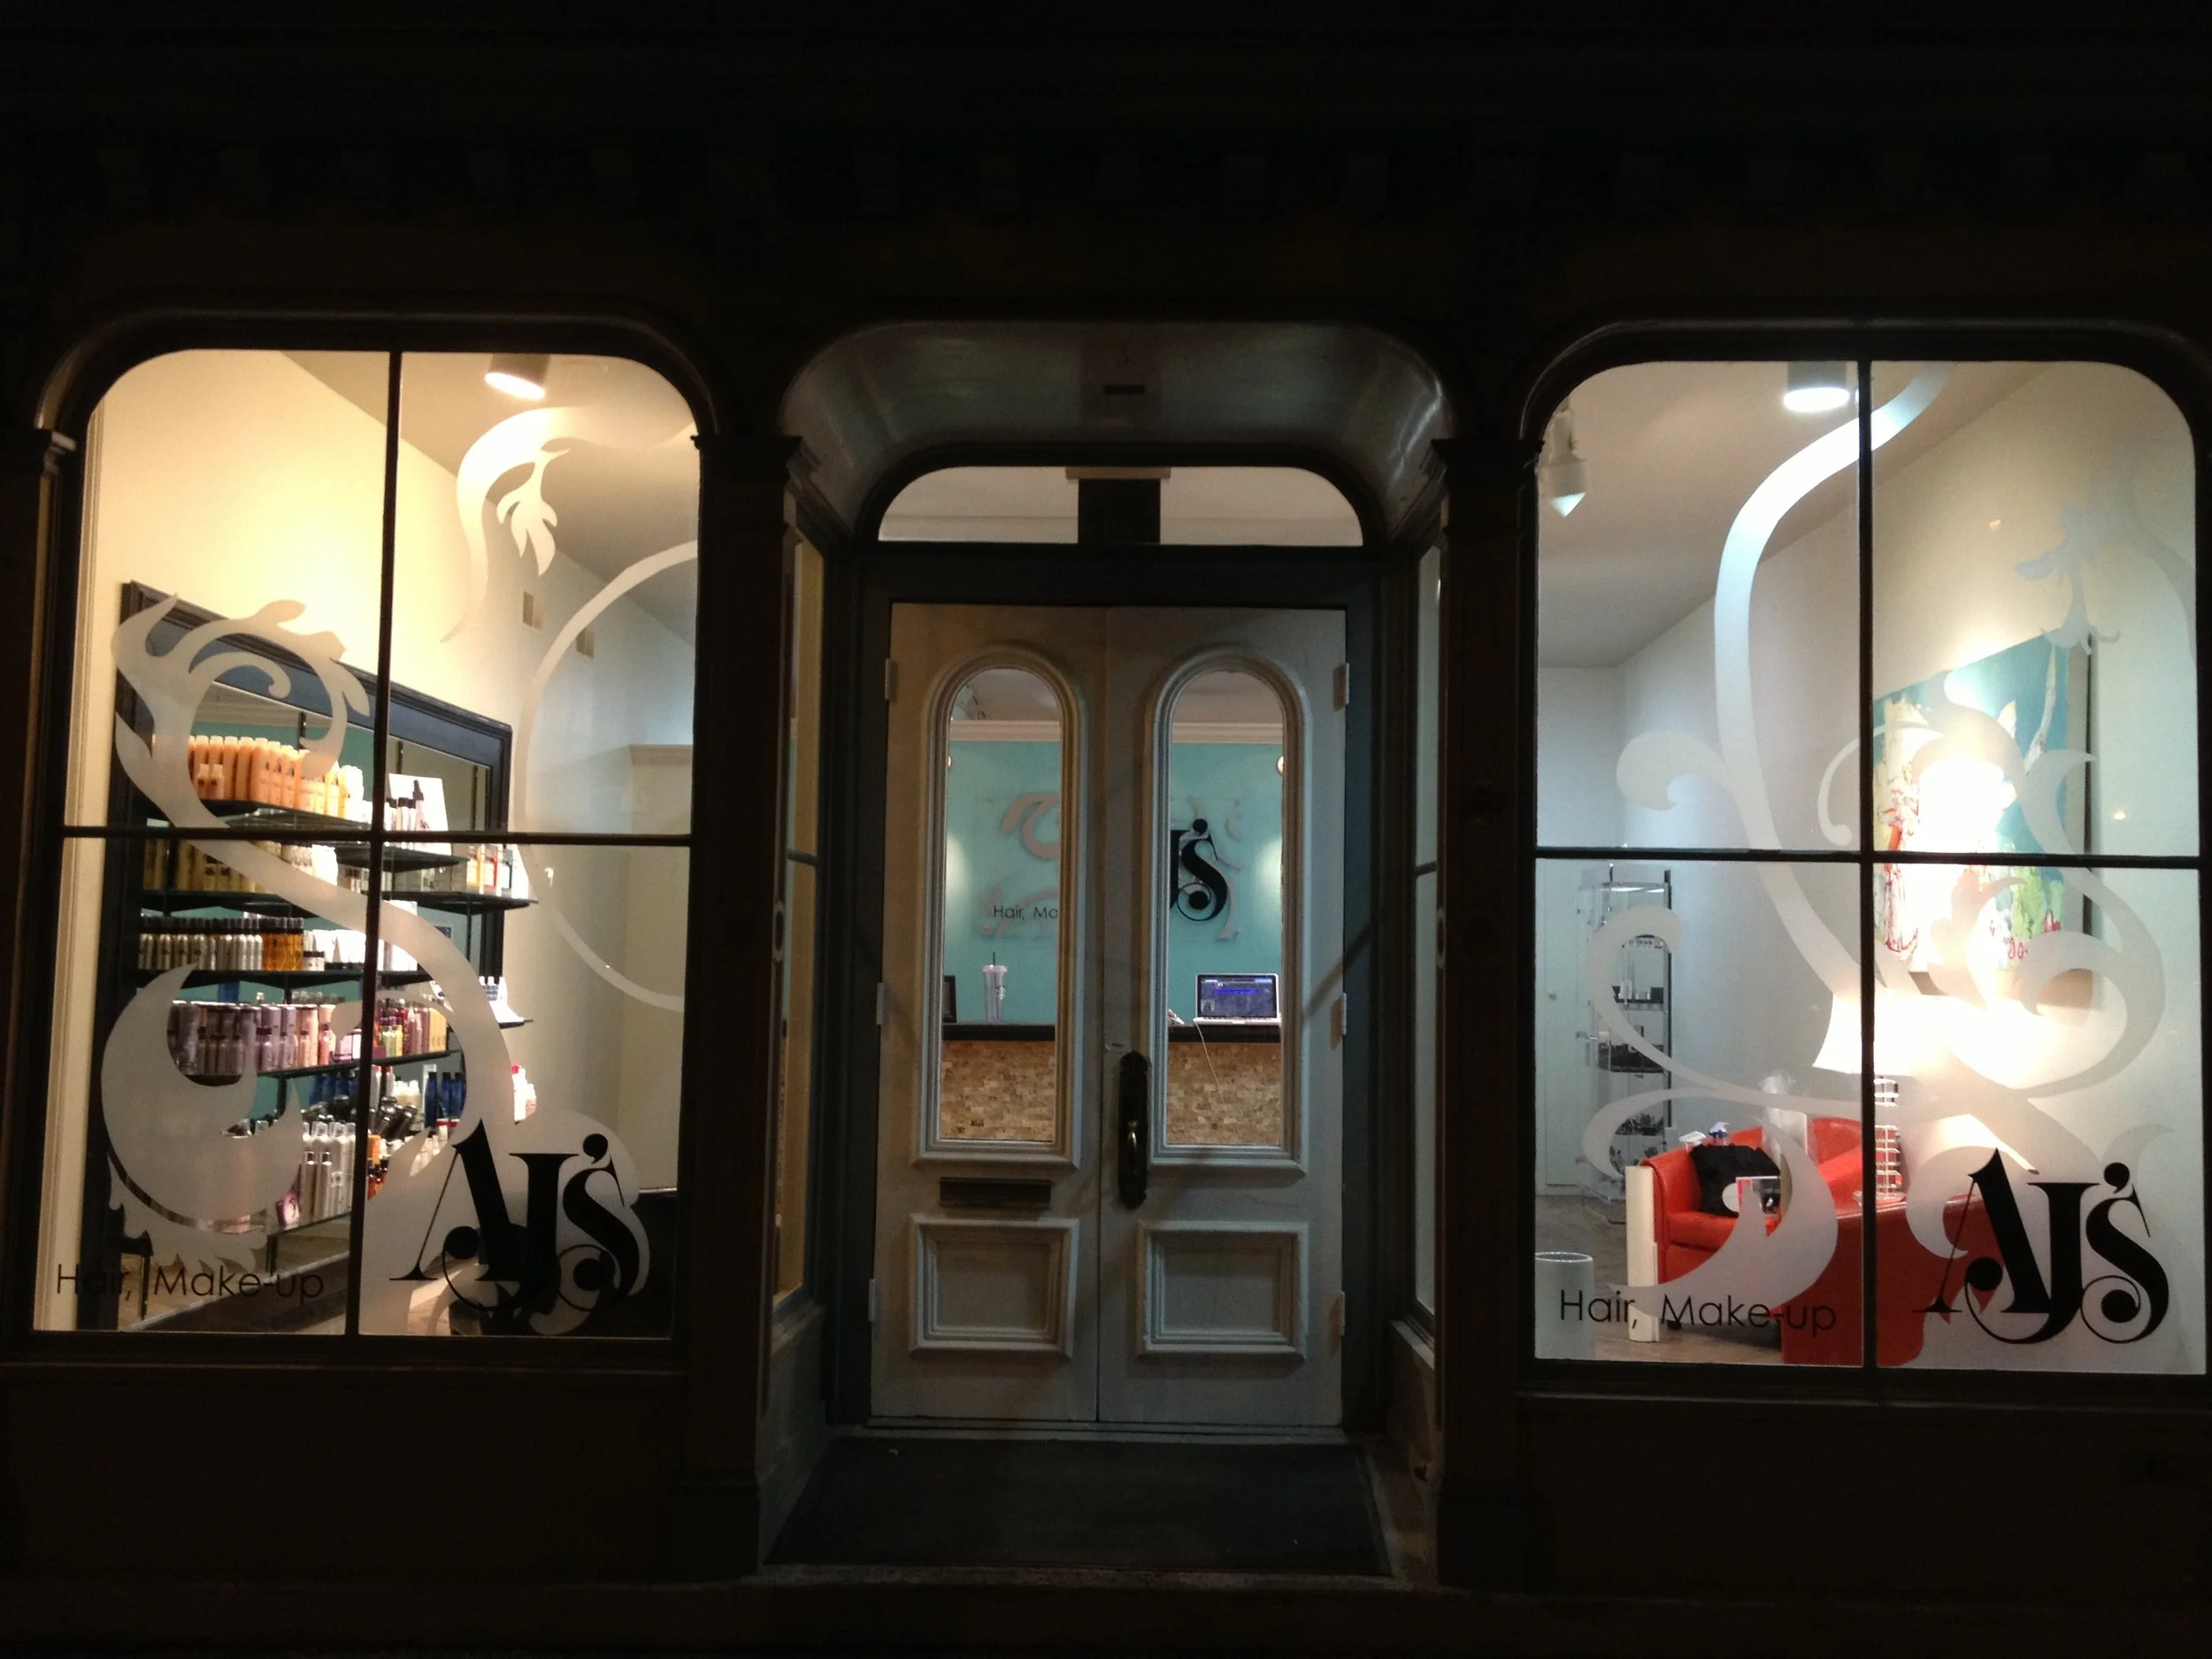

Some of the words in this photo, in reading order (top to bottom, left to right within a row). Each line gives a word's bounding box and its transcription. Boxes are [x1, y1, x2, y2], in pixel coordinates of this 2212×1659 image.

[993, 904, 1025, 920] Hair,
[1912, 1147, 2170, 1344] AJ'S
[57, 1263, 132, 1302] Hair,
[153, 1264, 325, 1305] Make-up
[1560, 1288, 1639, 1329] Hair,
[1660, 1294, 1837, 1335] Make-up
